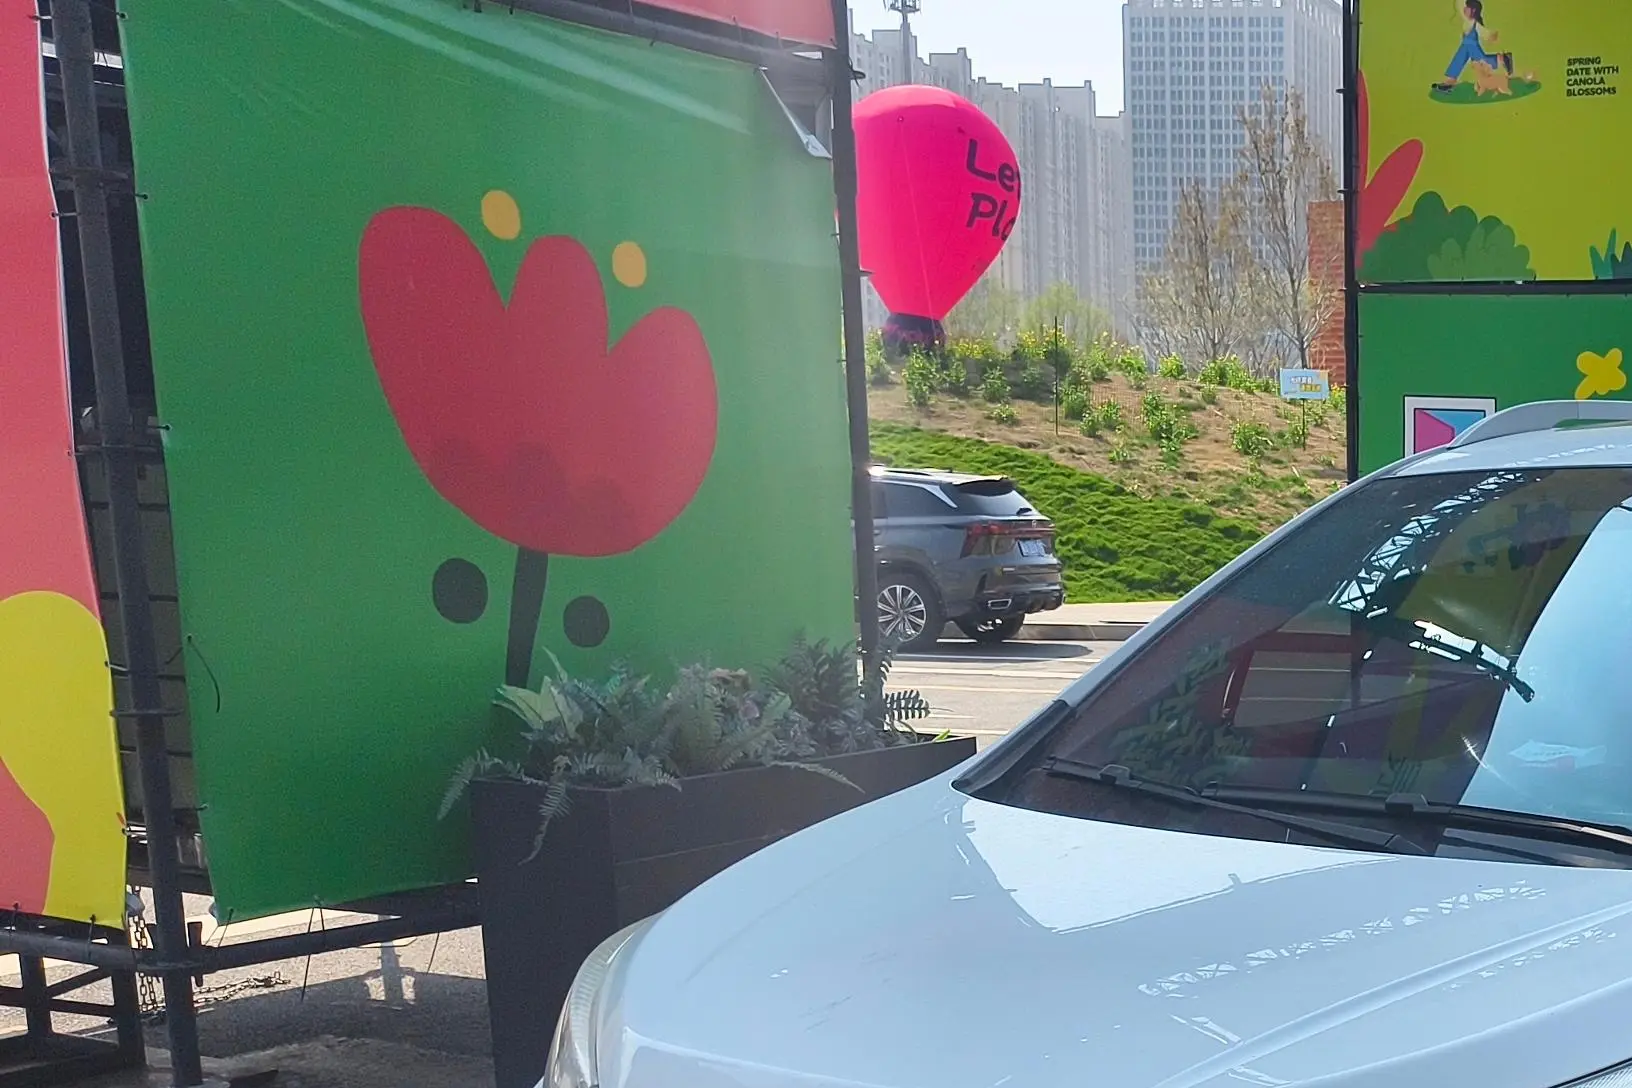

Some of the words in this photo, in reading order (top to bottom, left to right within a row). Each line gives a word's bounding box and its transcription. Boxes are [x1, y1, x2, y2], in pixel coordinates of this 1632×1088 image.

[1567, 56, 1602, 67] SPRING
[1566, 67, 1591, 77] DATE
[1593, 65, 1619, 75] WITH
[1566, 76, 1606, 87] CANOLA
[1566, 86, 1617, 97] BLOSSOMS
[966, 138, 1022, 201] Le
